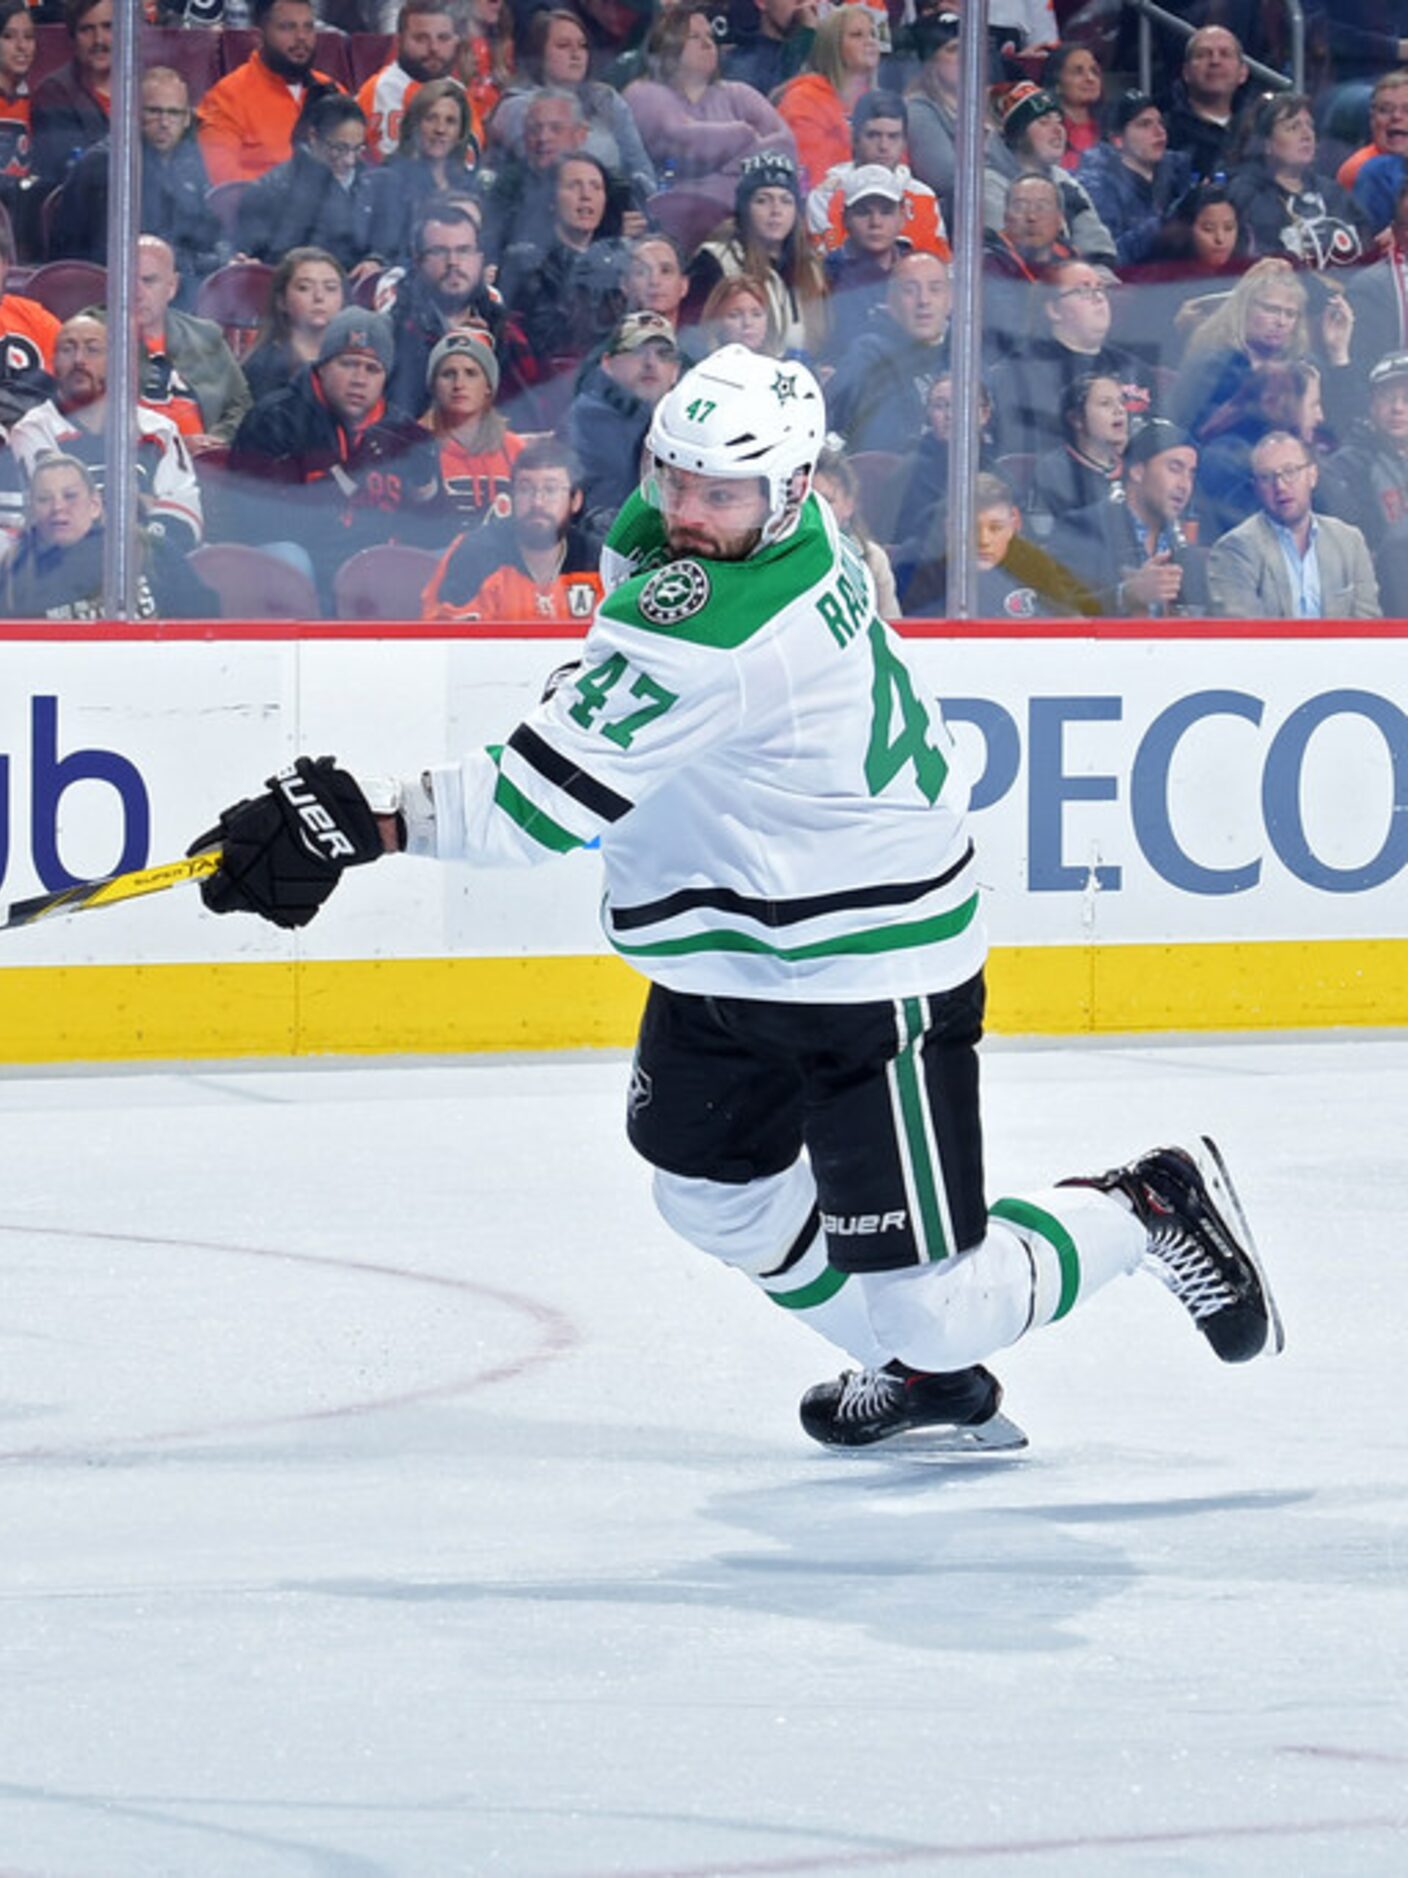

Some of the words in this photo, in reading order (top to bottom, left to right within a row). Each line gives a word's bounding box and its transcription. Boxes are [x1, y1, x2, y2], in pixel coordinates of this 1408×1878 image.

[685, 398, 717, 423] 47
[815, 573, 869, 650] RA
[568, 651, 680, 750] 47
[864, 616, 950, 809] 4
[278, 765, 355, 860] AUER
[936, 689, 1408, 895] PECO
[819, 1210, 907, 1236] AUER
